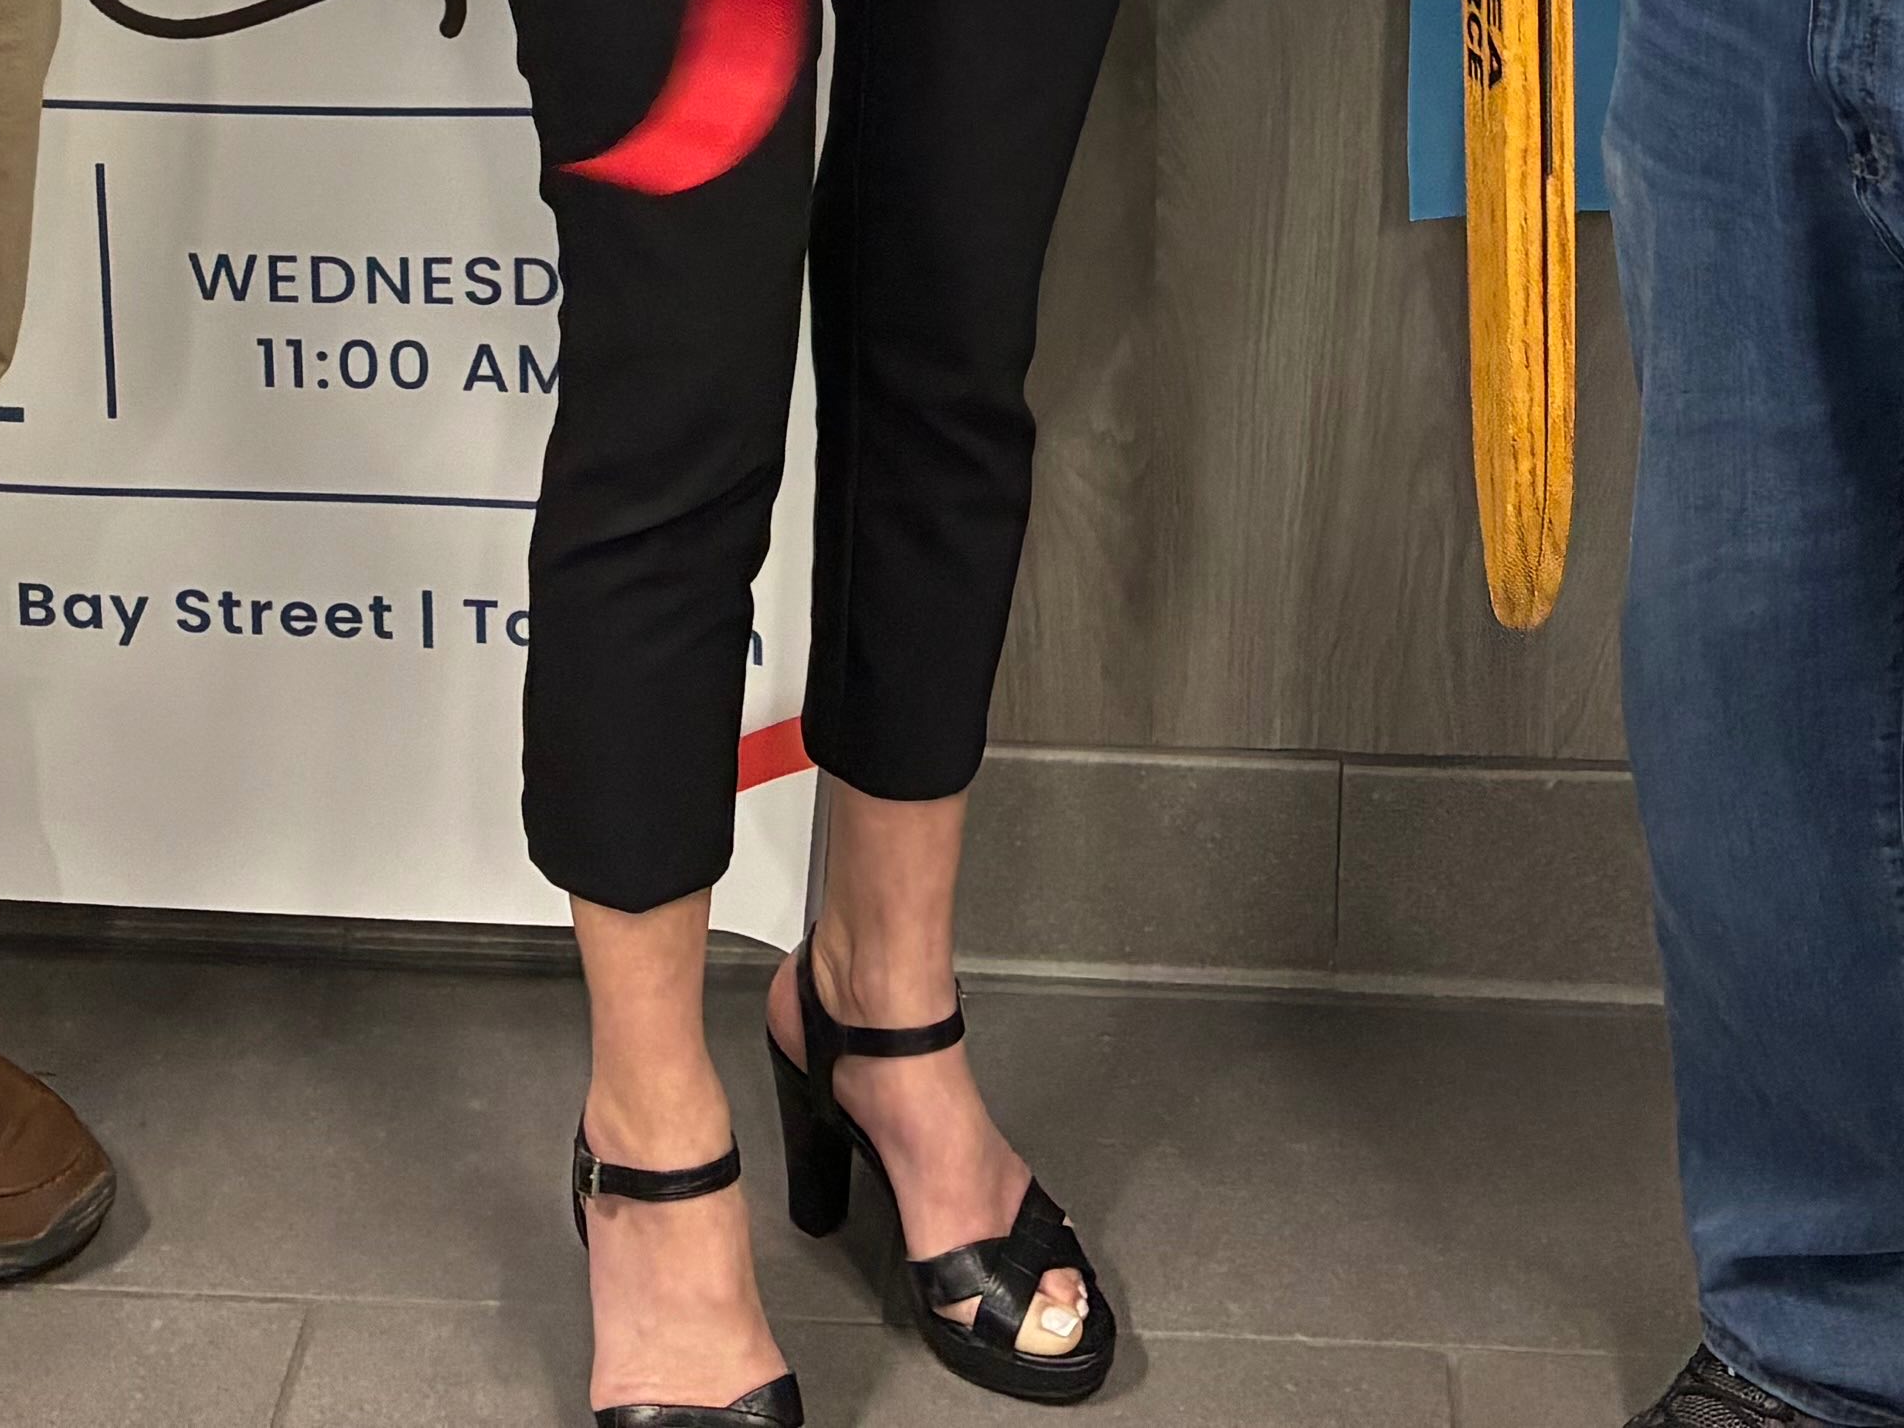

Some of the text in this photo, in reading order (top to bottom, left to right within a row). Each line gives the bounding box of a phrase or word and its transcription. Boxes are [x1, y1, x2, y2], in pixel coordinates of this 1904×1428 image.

[188, 252, 562, 305] WEDNESD
[257, 338, 561, 394] 11:00 AM
[19, 583, 395, 646] Bay Street
